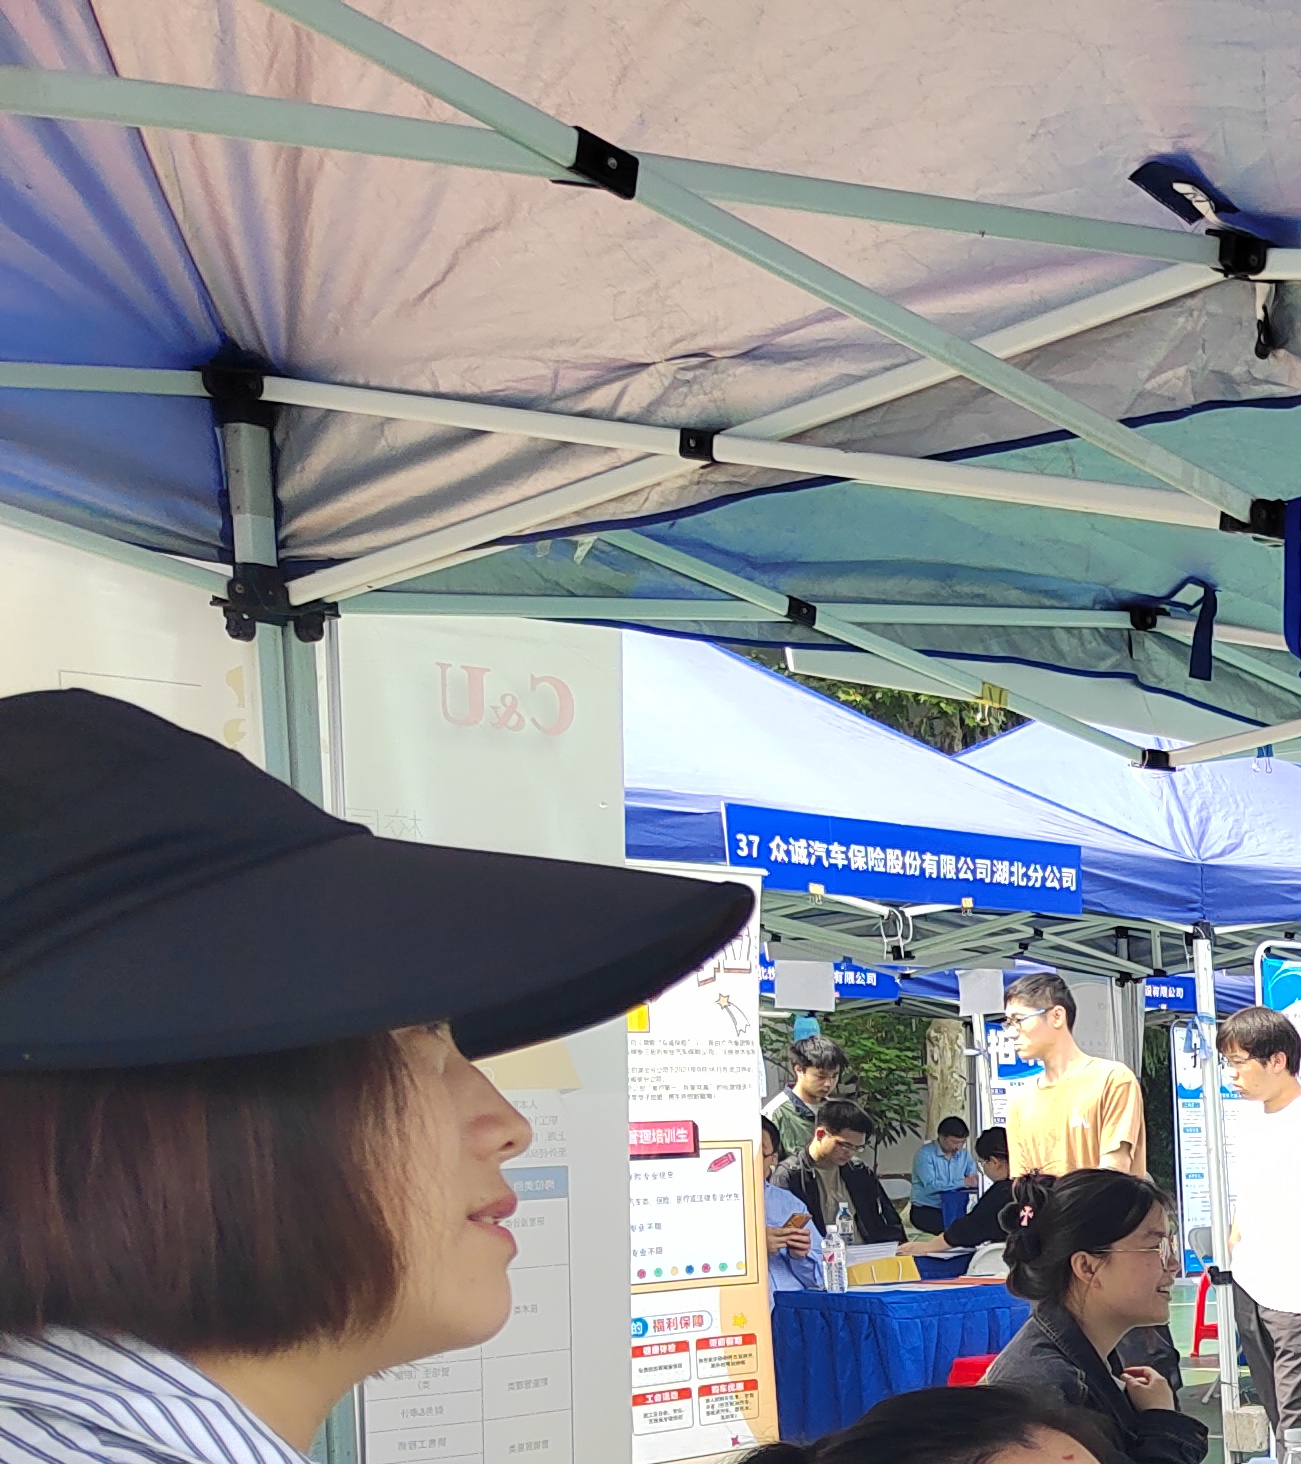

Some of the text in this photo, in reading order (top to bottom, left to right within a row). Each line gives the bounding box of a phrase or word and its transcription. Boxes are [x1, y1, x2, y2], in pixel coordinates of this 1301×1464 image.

[735, 833, 1077, 892] 37 众诚汽车保险股份有限公司湖北分公司
[652, 1314, 705, 1333] 福利保障
